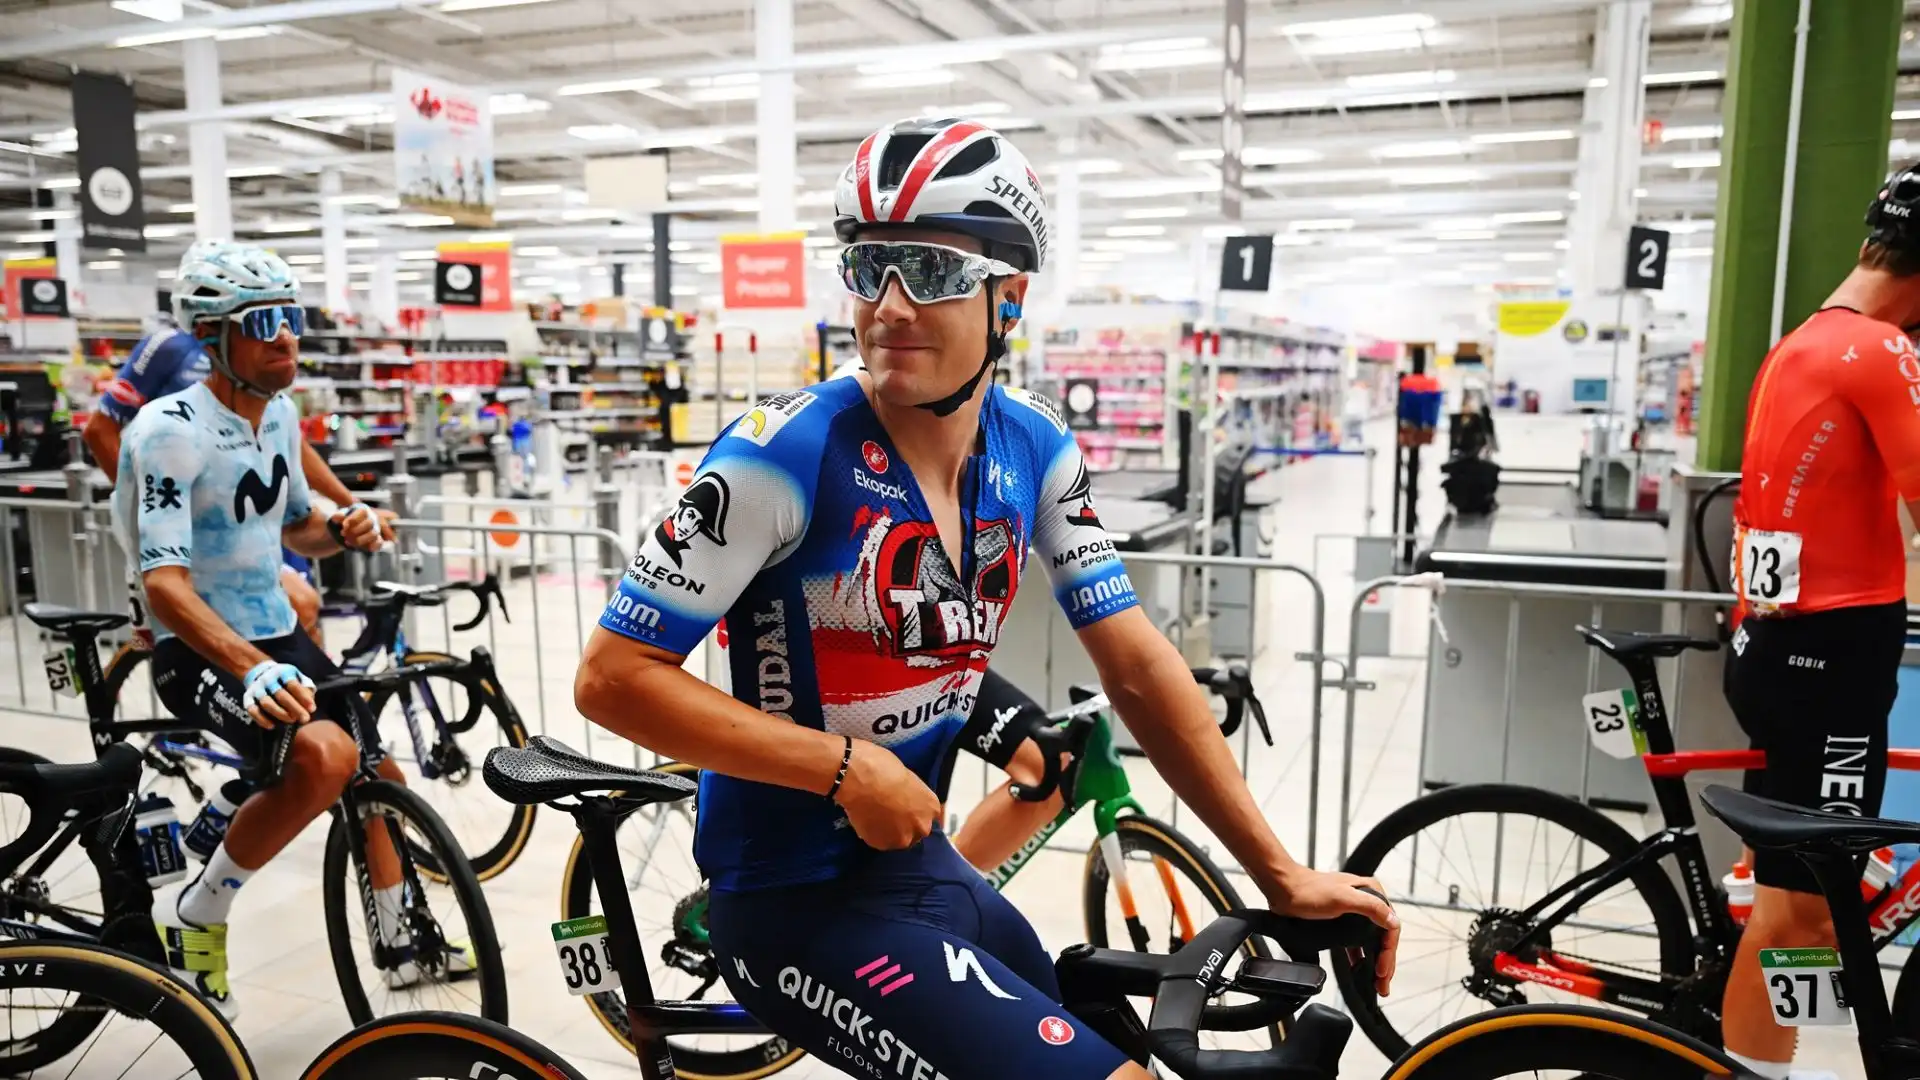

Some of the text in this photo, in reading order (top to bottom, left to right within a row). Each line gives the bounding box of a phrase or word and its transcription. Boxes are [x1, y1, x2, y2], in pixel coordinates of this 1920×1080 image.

[985, 175, 1048, 266] SPECIALIZ
[736, 253, 788, 275] Super
[1239, 244, 1254, 282] 1
[1637, 239, 1659, 278] 2
[853, 467, 908, 502] Ekopak
[1781, 420, 1837, 518] GRENADIER
[143, 473, 156, 514] vivo
[634, 554, 706, 596] OLEON
[1749, 545, 1782, 599] 23
[45, 653, 71, 690] 125
[1788, 655, 1826, 670] GOBIK
[977, 704, 1023, 753] Rapha
[1590, 703, 1624, 734] 23
[1688, 859, 1713, 929] GRENADIER
[573, 921, 602, 933] plenitude
[561, 943, 602, 988] 38
[1791, 953, 1834, 962] plenitude
[1771, 974, 1818, 1019] 37
[827, 1036, 883, 1080] FLOORS
